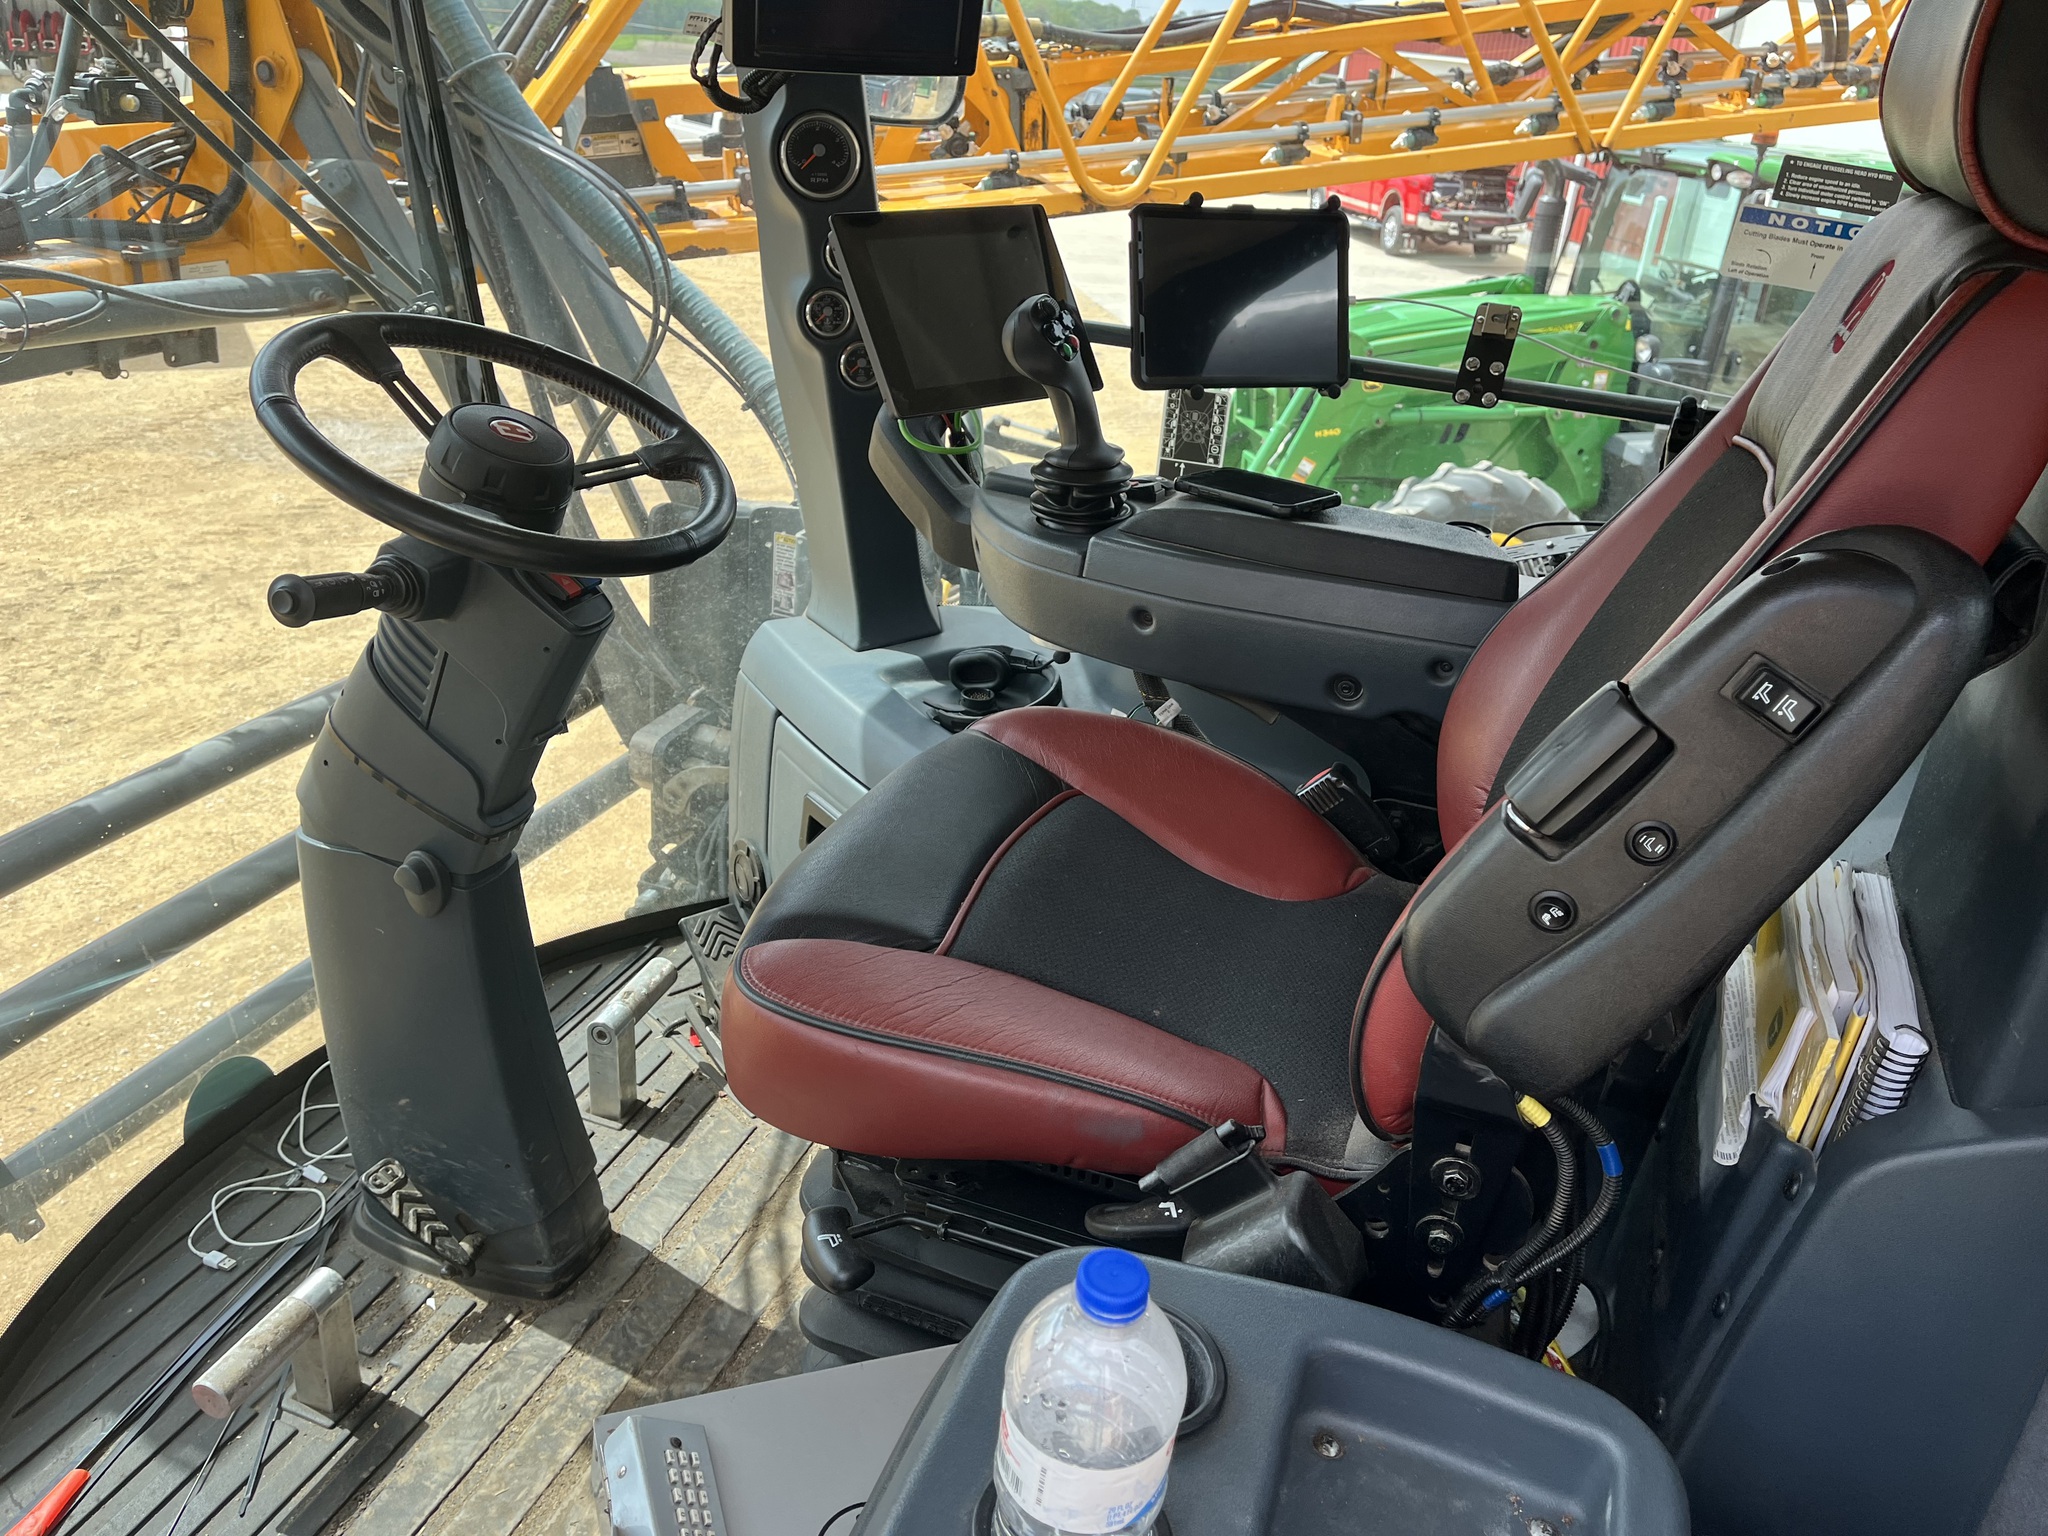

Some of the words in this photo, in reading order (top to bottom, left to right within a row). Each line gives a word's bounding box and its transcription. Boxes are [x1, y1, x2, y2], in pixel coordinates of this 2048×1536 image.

[1803, 161, 1822, 169] ENGAGE
[1854, 169, 1867, 177] HEAD
[1818, 184, 1847, 193] unauthorized
[1785, 191, 1800, 199] Slowly
[1800, 194, 1820, 202] increase
[1798, 187, 1820, 195] individual
[1851, 196, 1871, 204] switches
[1744, 229, 1767, 239] Cutting
[1769, 233, 1790, 243] Blades
[1792, 237, 1808, 246] Must
[1810, 240, 1835, 251] Operate
[1745, 270, 1769, 278] Operation
